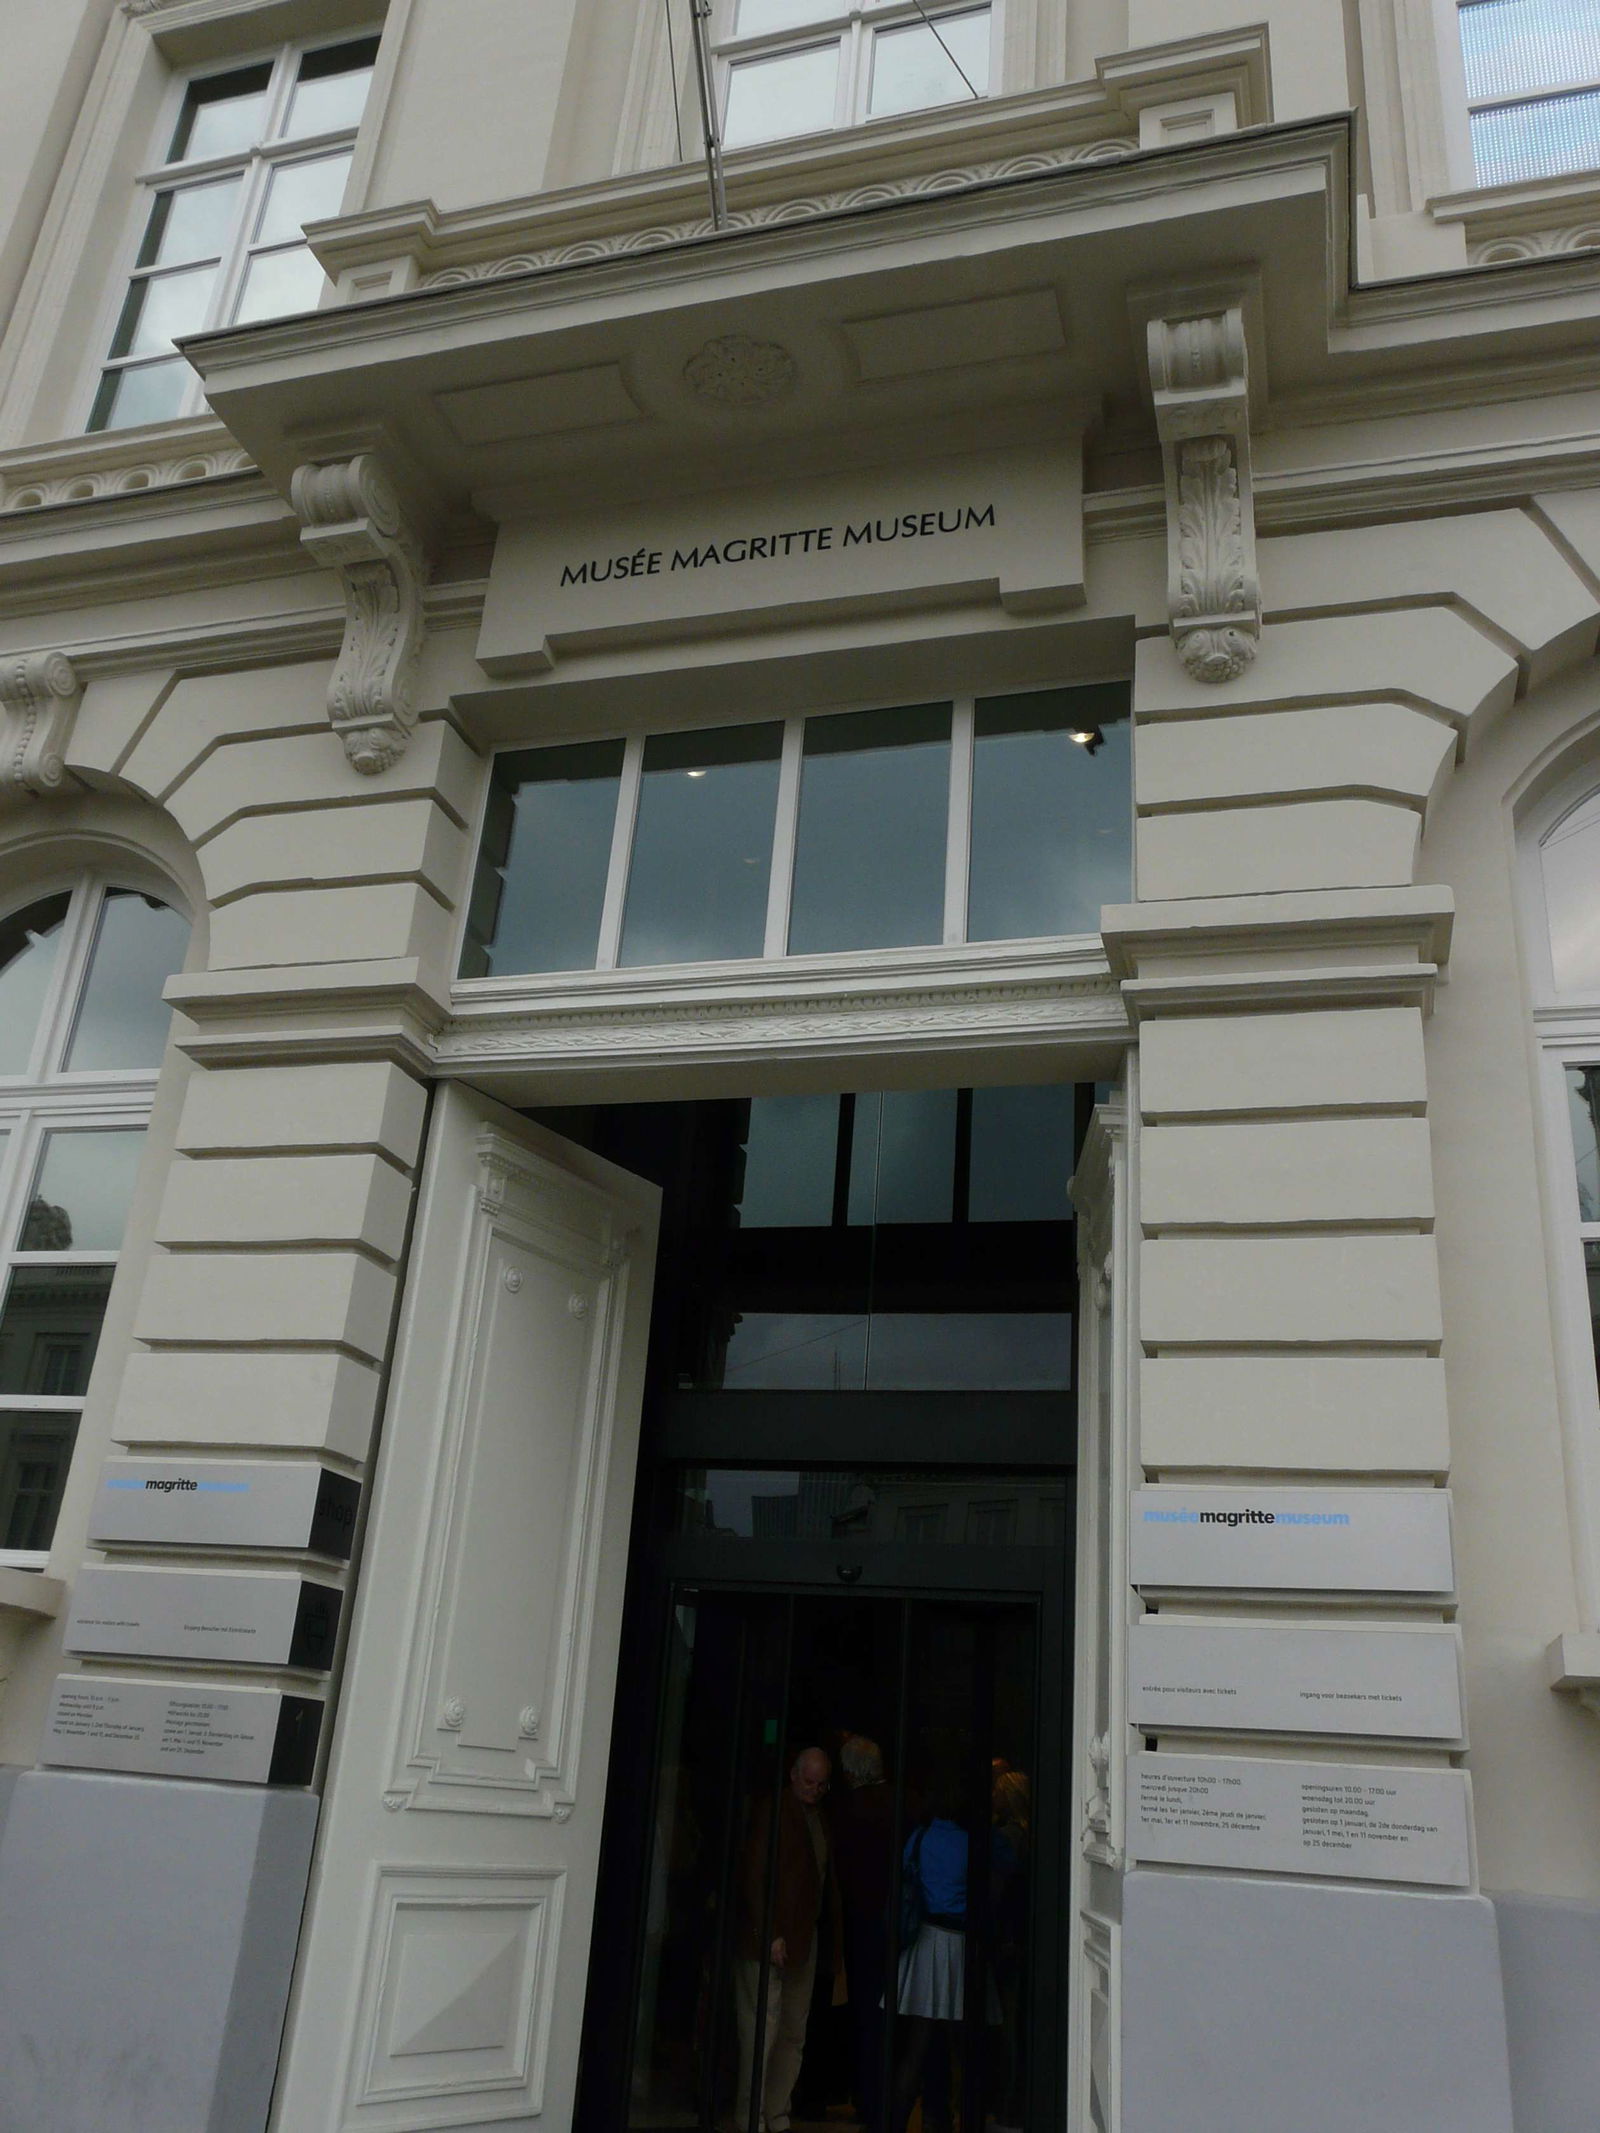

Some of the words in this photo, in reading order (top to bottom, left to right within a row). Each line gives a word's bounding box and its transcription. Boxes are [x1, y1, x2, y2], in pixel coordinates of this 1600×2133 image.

[561, 549, 662, 586] MUSÉE
[670, 527, 834, 571] MAGRITTE
[842, 504, 994, 547] MUSEUM
